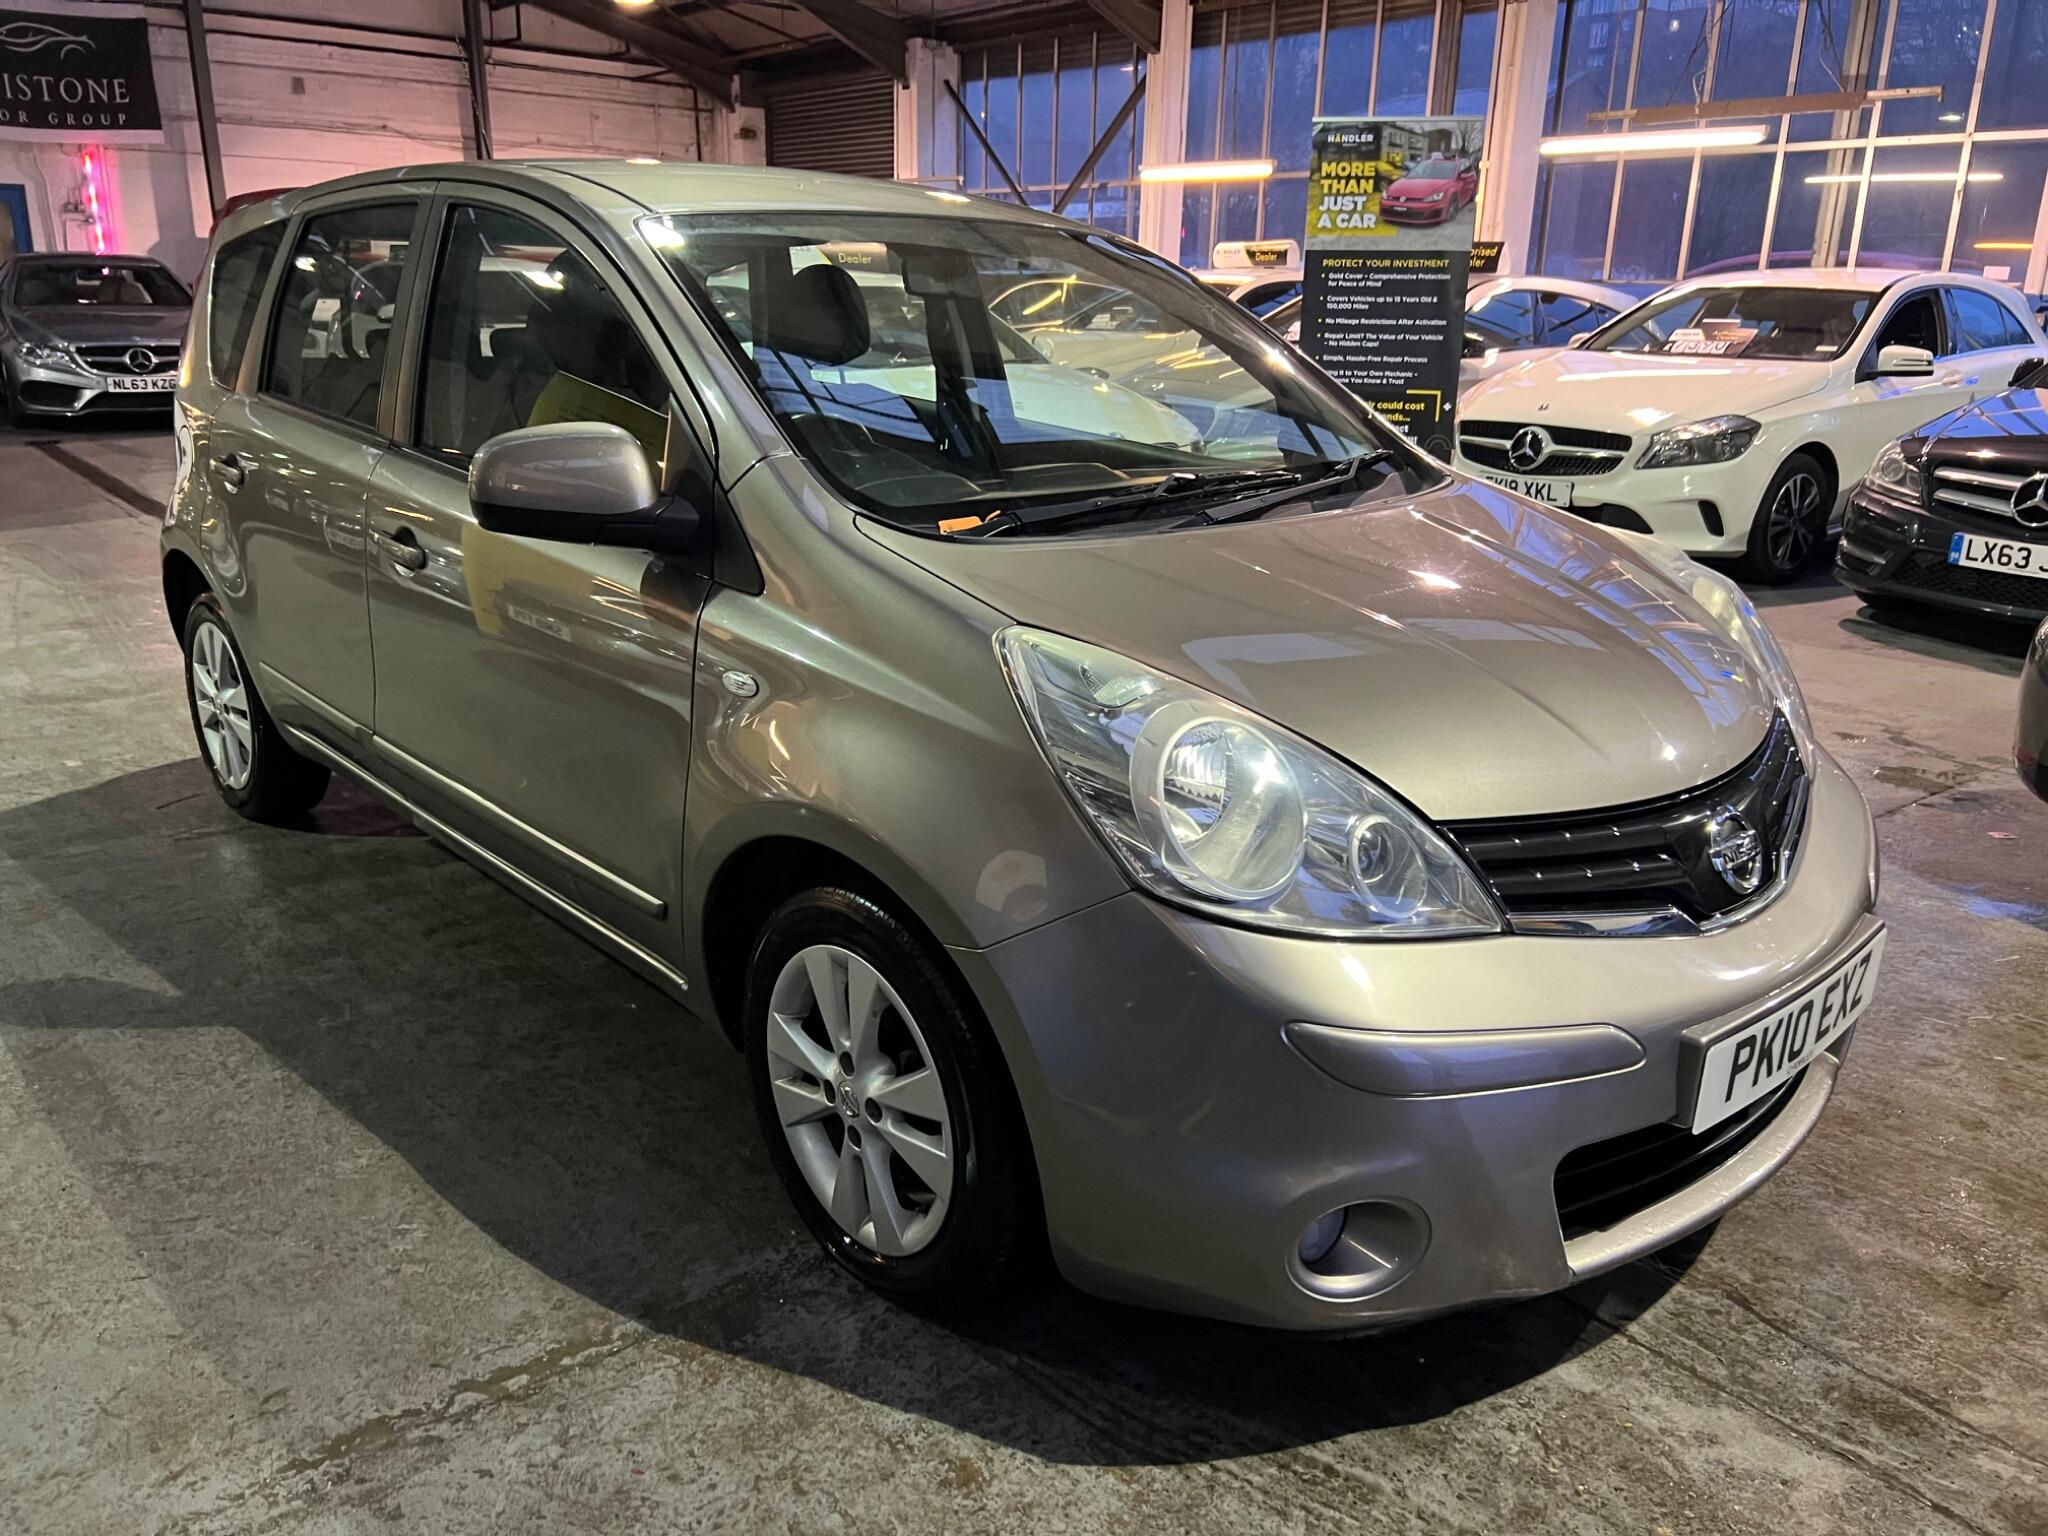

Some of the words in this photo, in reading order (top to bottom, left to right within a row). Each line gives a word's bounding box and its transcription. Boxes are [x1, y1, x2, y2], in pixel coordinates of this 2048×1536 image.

[48, 113, 126, 126] GROUP
[1321, 162, 1376, 177] MORE
[1321, 179, 1373, 193] THAN
[1319, 196, 1367, 211] JUST
[1317, 214, 1331, 228] A
[1336, 214, 1376, 229] CAR
[838, 253, 872, 264] Dealer
[1323, 259, 1363, 268] PROTECT
[1366, 259, 1391, 268] YOUR
[1393, 259, 1449, 268] INVESTMENT
[1369, 273, 1417, 281] Comprehensive
[1335, 318, 1359, 326] Mileage
[1324, 333, 1344, 341] Repair
[113, 379, 148, 390] NL63
[1377, 401, 1403, 410] could
[1405, 402, 1425, 411] cost
[1524, 481, 1557, 502] XKL
[1965, 538, 2032, 569] LX63
[1725, 999, 1815, 1104] PK10
[1815, 950, 1873, 1045] EXZ
